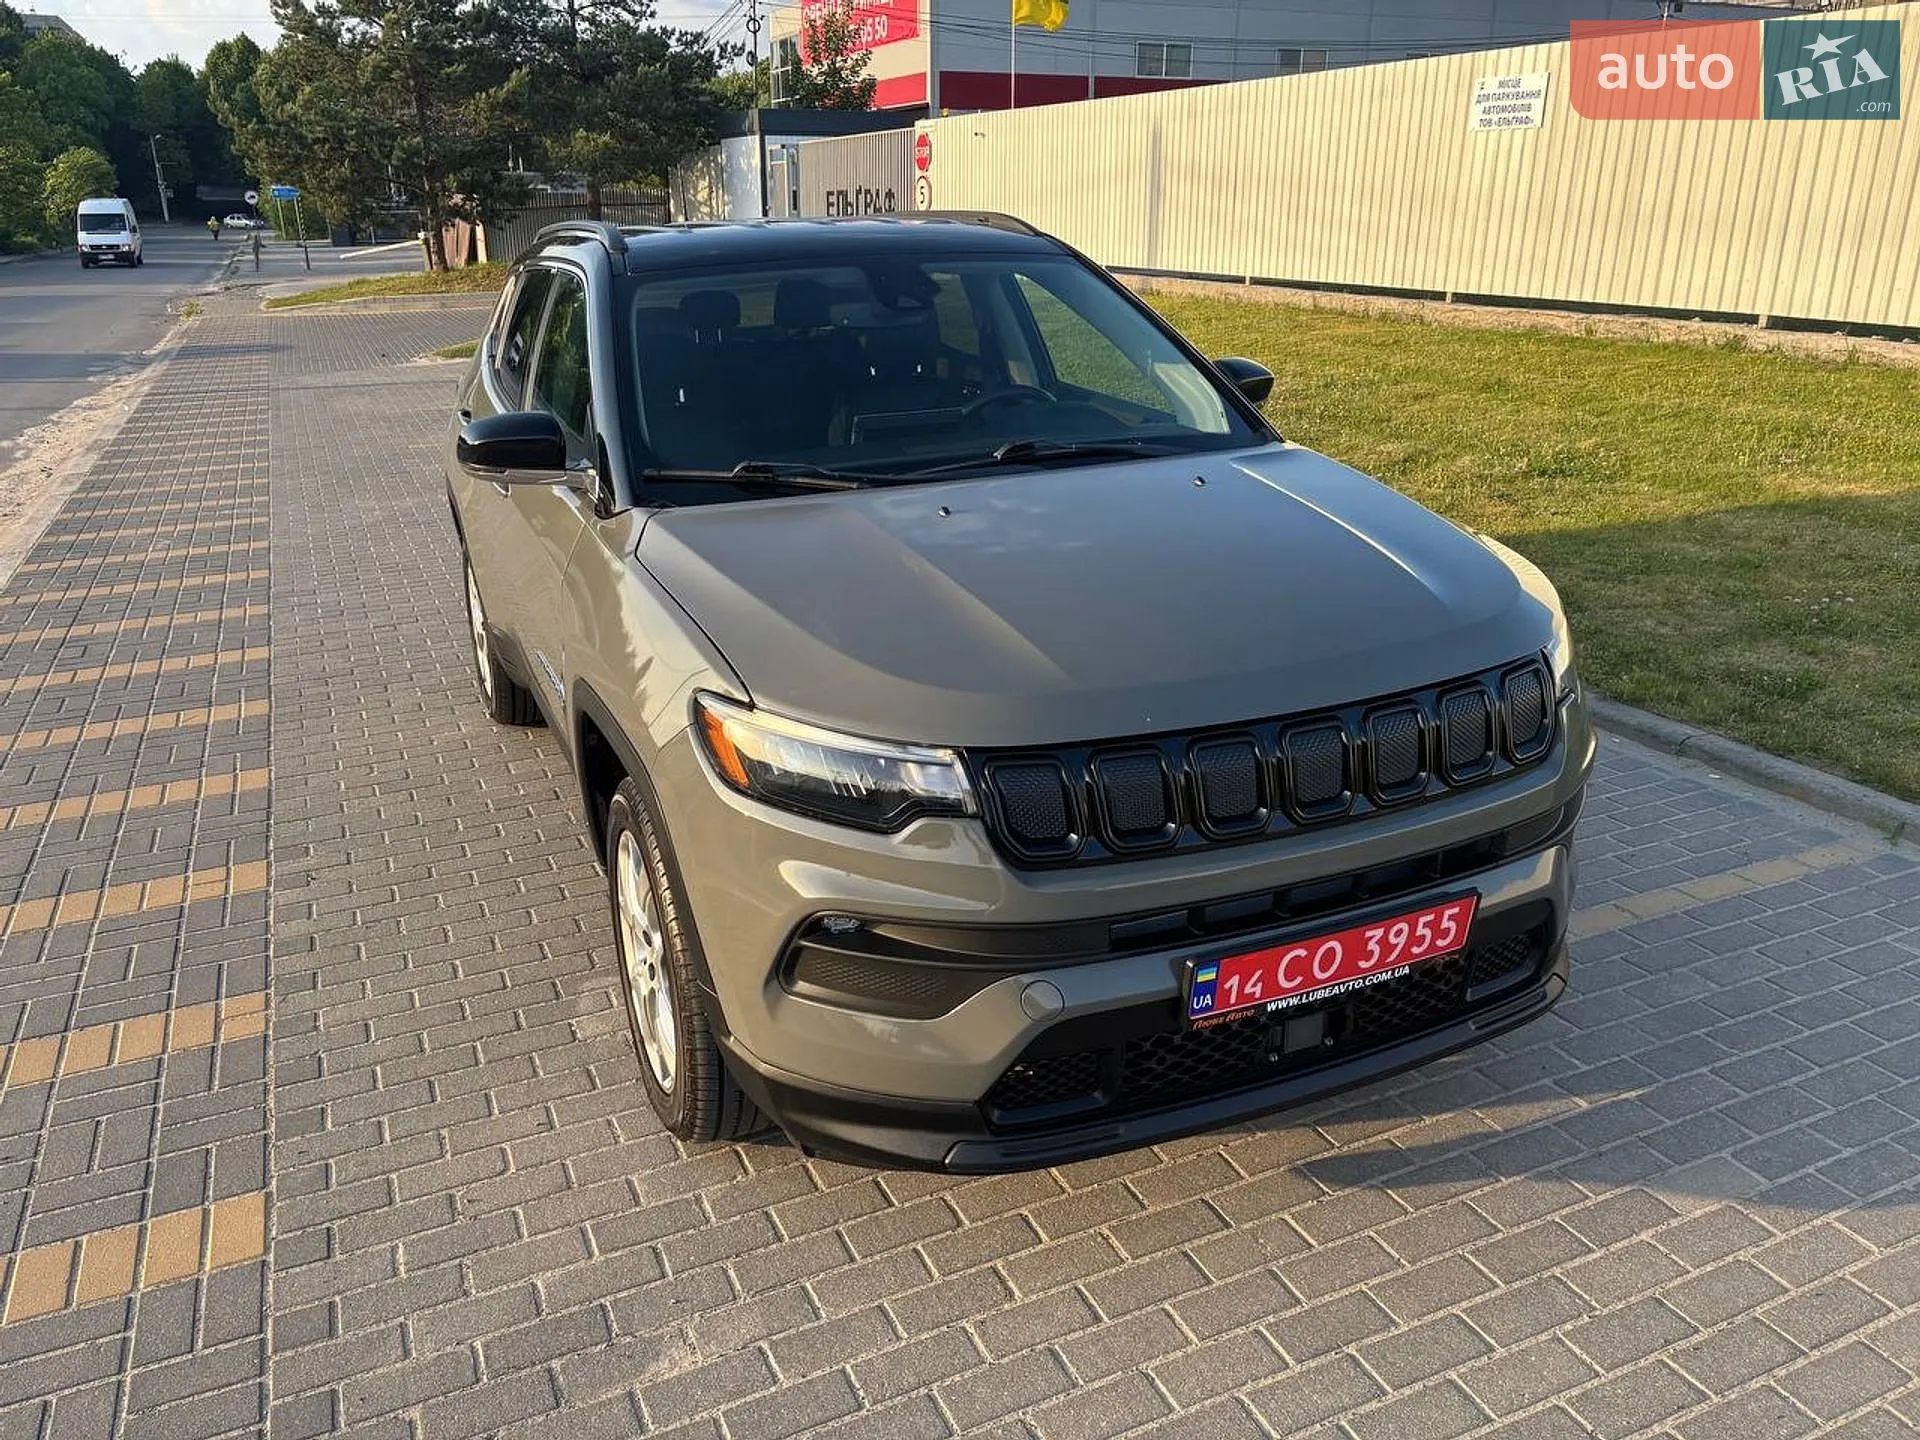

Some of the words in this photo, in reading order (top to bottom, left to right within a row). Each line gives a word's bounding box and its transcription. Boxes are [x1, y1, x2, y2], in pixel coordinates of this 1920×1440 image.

[1475, 92, 1490, 105] ДЛЯ
[1491, 89, 1542, 102] ПАРКУВАННЯ
[1482, 102, 1532, 116] АВТОМОБІЛІВ
[1479, 118, 1494, 128] ТОВ
[919, 185, 926, 205] 5
[1223, 969, 1263, 1005] 14
[1276, 940, 1344, 989] CO
[1357, 906, 1461, 969] 3955
[1266, 965, 1411, 1012] WWW.LUBEAVTO.COM.UA
[1193, 993, 1212, 1009] UA
